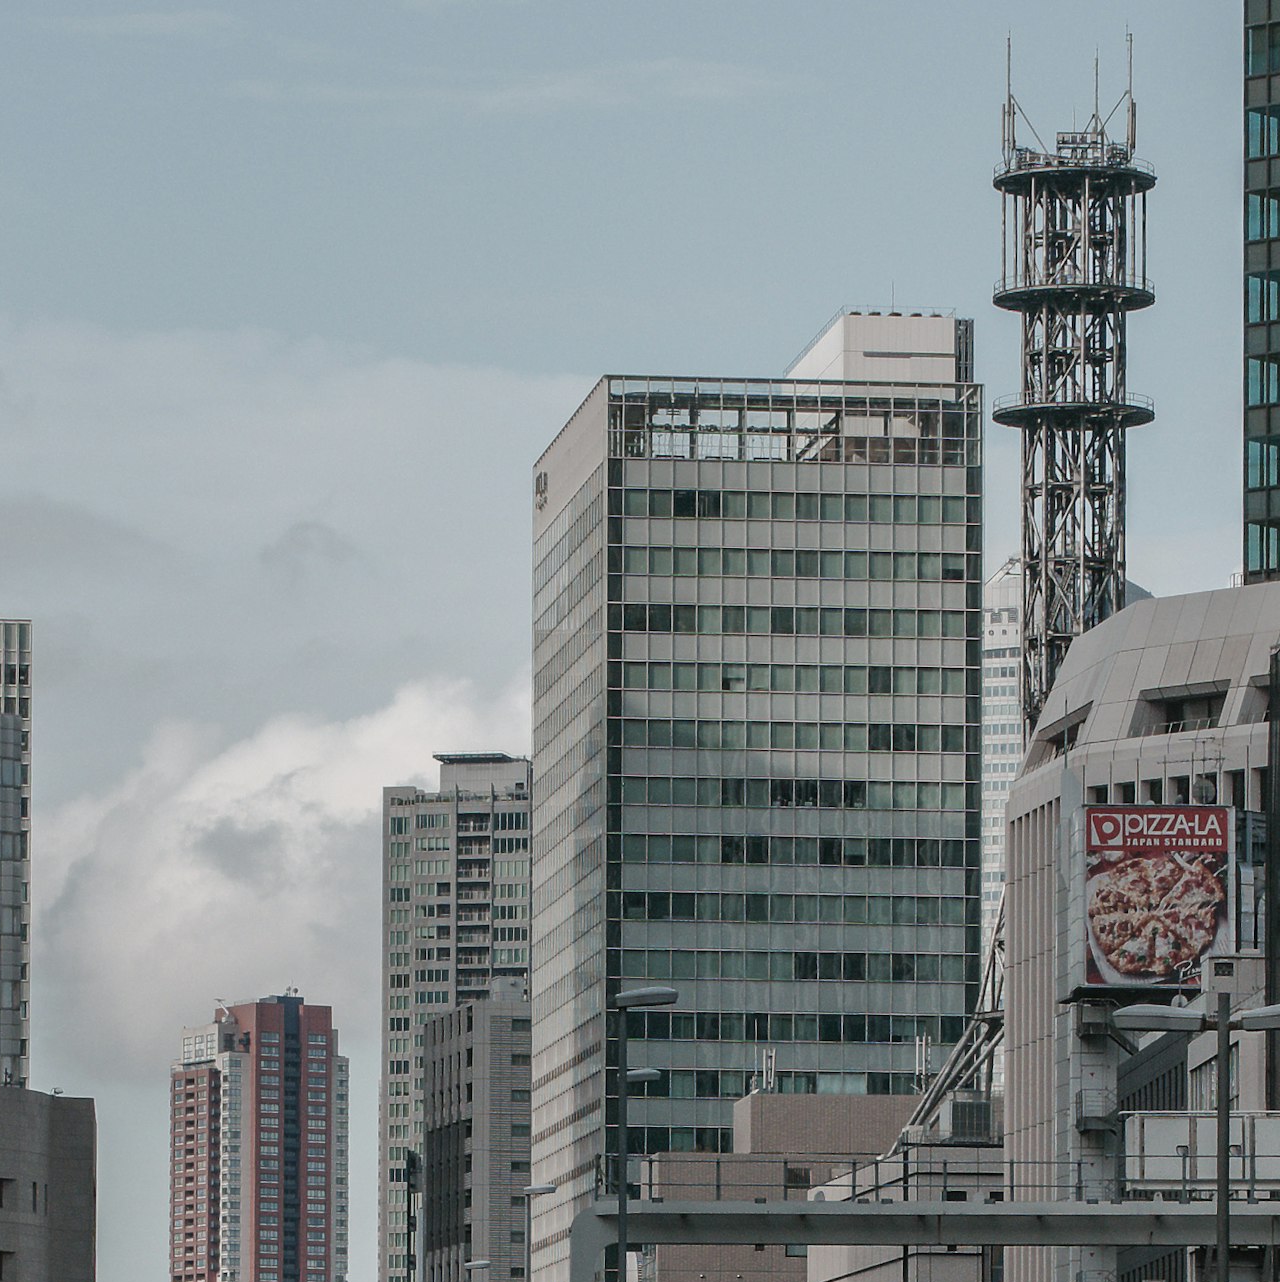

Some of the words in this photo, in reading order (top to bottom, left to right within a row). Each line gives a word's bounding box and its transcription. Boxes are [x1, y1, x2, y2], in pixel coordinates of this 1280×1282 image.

[1125, 814, 1222, 836] PIZZA-LA
[1126, 838, 1160, 846] JAPAN
[1164, 838, 1223, 846] STANDARD
